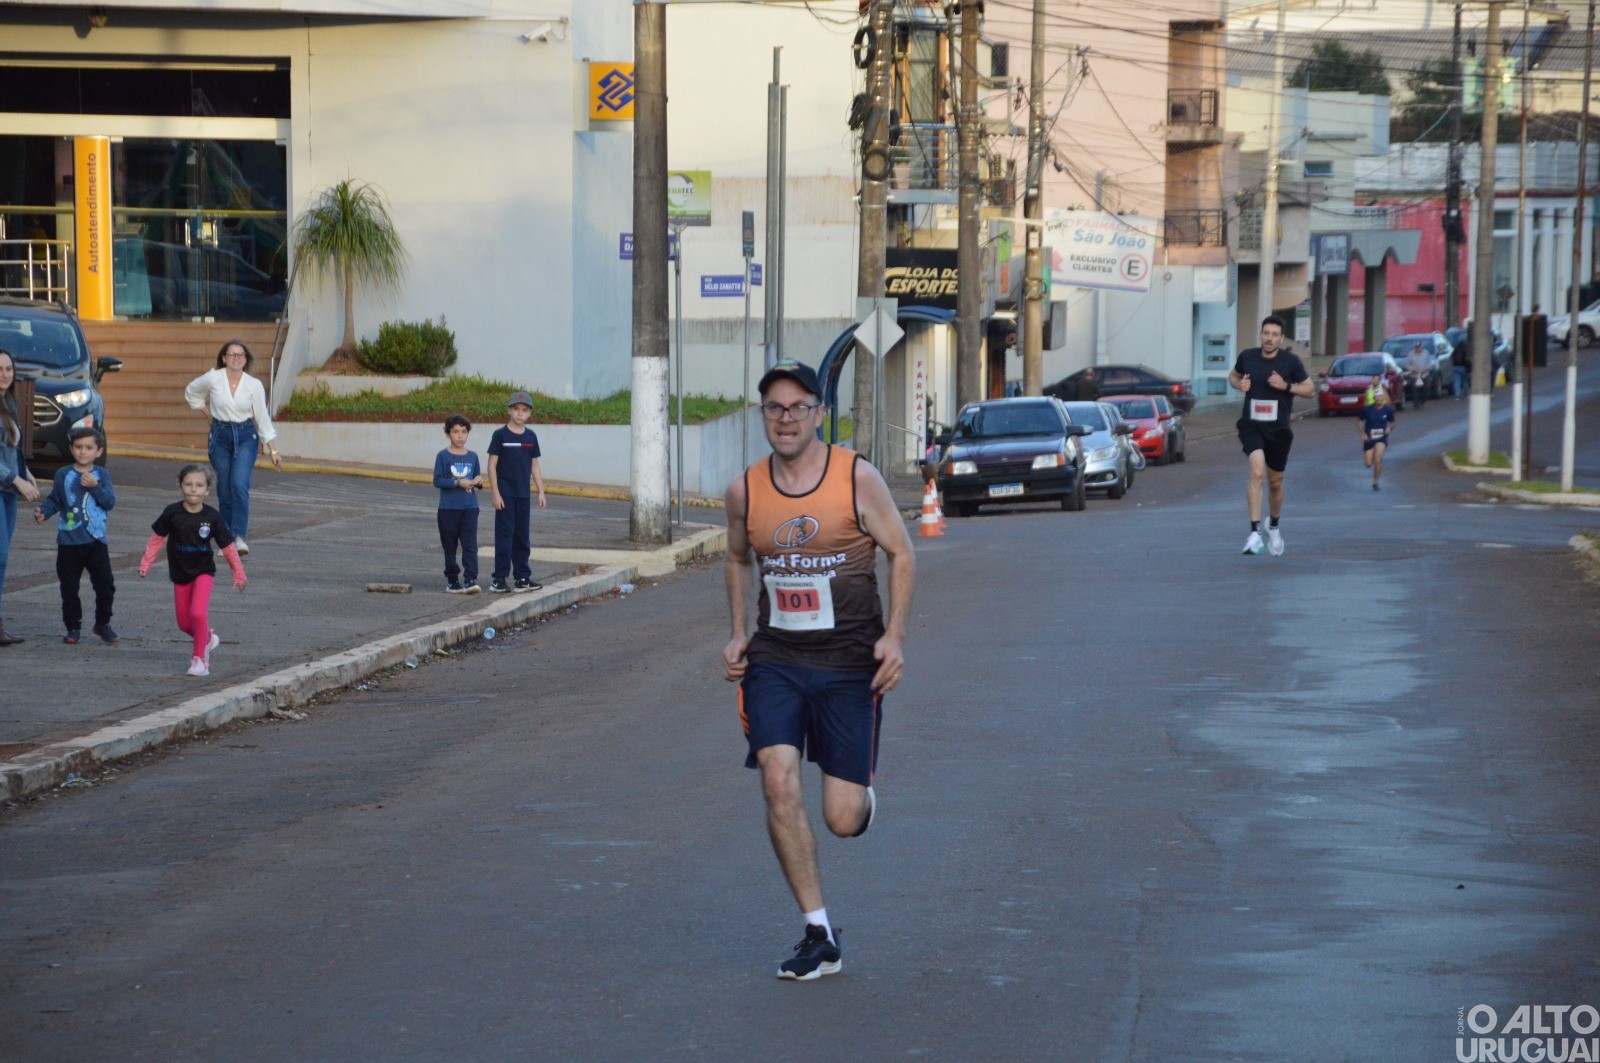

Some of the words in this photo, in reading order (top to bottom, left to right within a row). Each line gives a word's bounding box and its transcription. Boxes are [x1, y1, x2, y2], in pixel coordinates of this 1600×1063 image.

[87, 153, 98, 274] Autoatendimento
[1073, 228, 1105, 244] São
[1108, 231, 1147, 249] João
[1070, 254, 1117, 265] EXCLUSIVO
[905, 267, 938, 278] LOJA
[1072, 263, 1113, 273] CLIENTES
[1127, 259, 1141, 276] E
[889, 279, 958, 294] ESPORTE
[790, 553, 847, 568] Forma
[780, 592, 812, 609] 101
